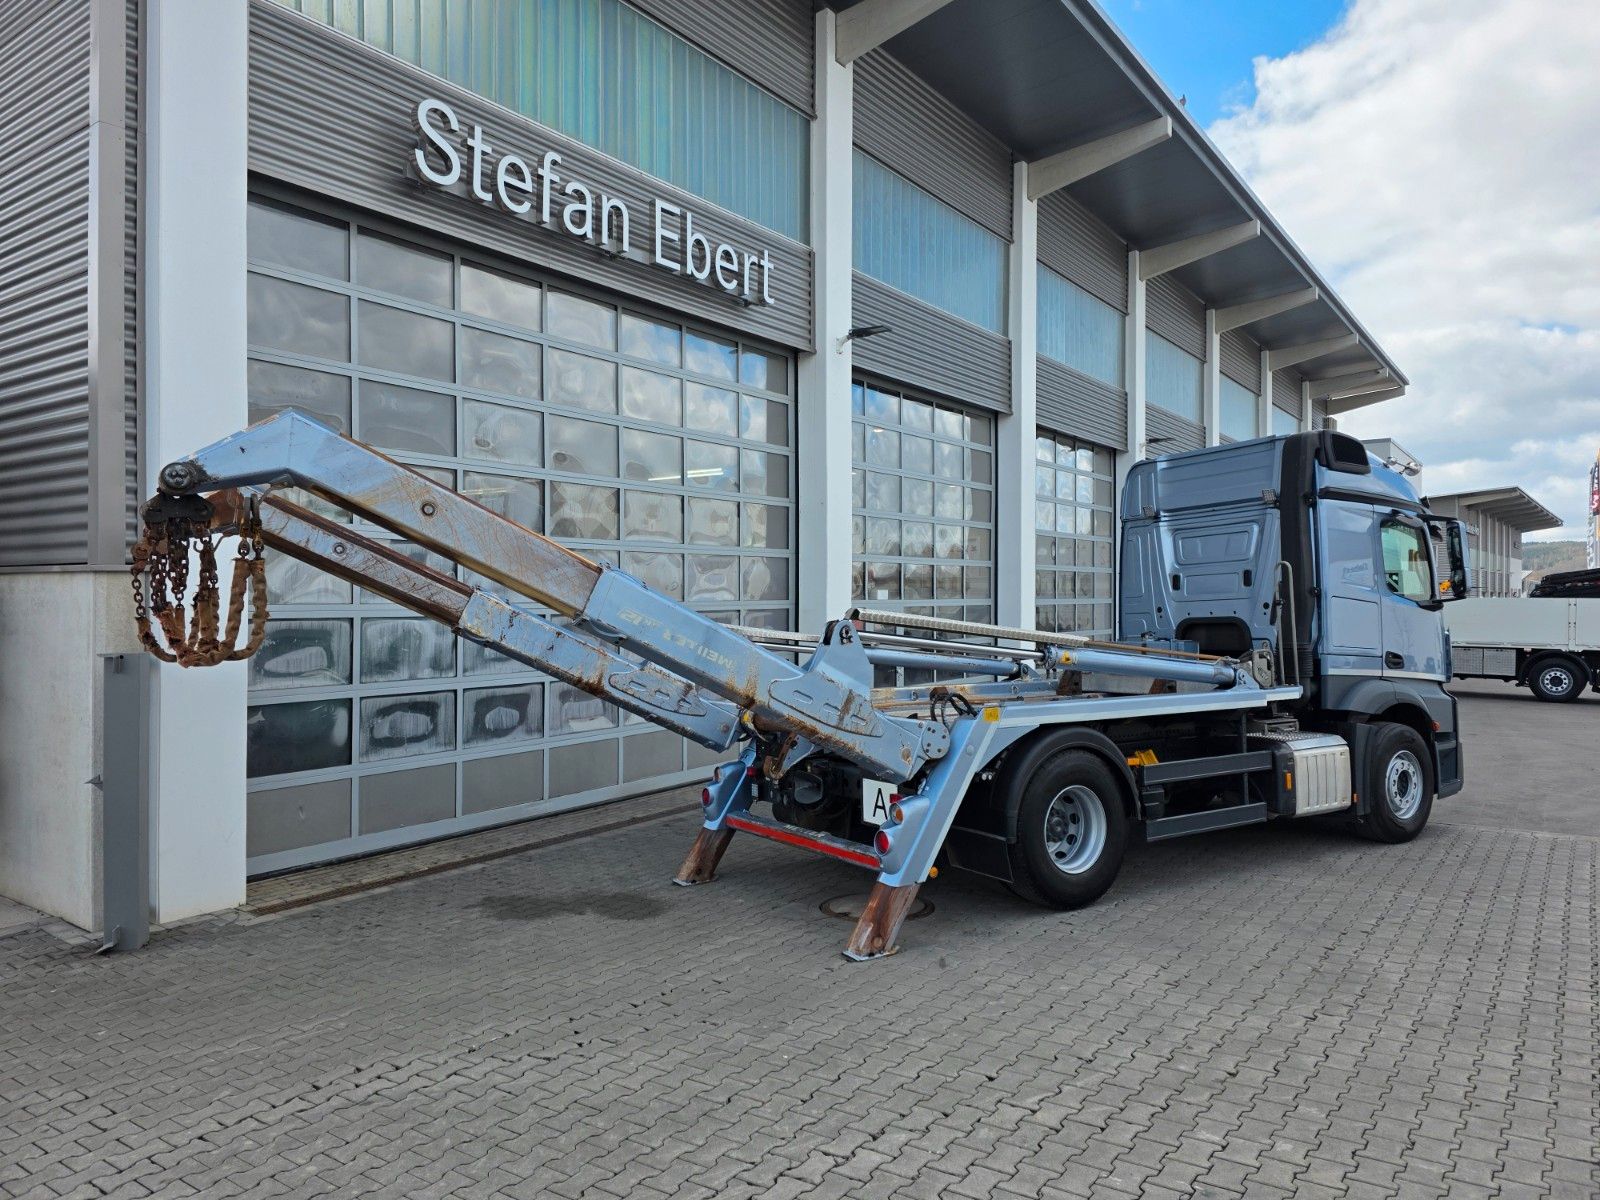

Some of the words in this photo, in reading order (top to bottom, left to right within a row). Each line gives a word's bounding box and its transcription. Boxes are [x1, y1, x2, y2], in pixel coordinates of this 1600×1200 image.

[414, 98, 629, 253] Stefan
[655, 199, 775, 305] Ebert
[872, 787, 888, 821] A
